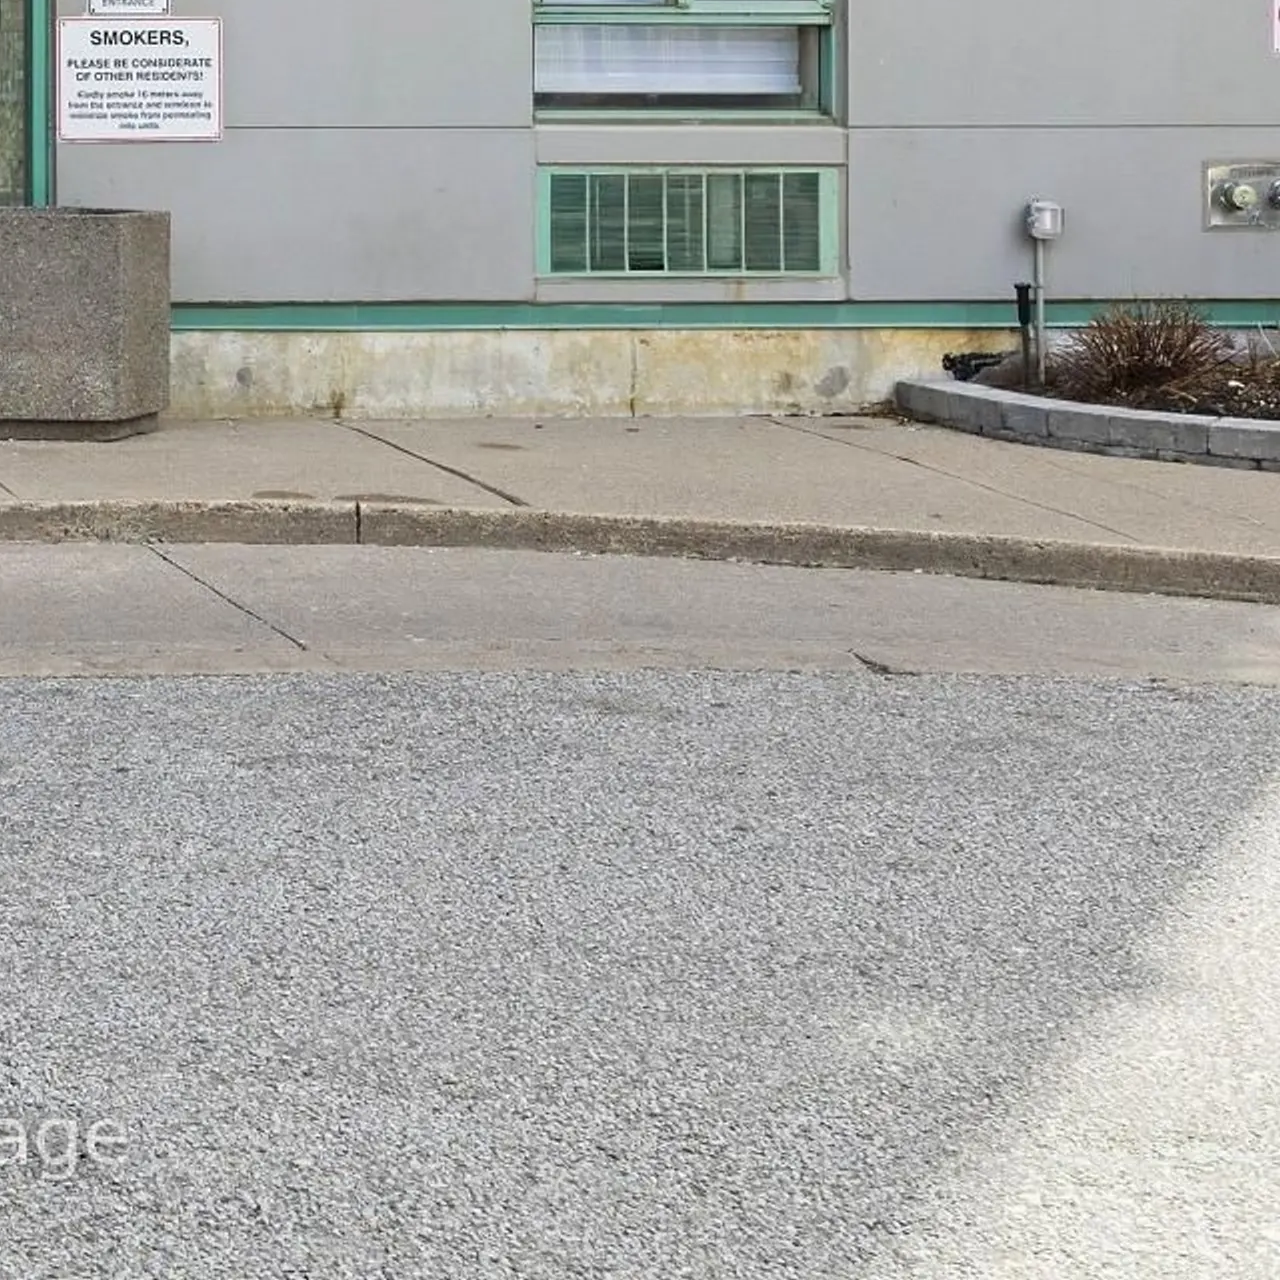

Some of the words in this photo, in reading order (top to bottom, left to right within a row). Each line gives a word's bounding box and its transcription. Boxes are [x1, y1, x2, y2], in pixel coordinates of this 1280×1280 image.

[90, 29, 190, 47] SMOKERS,
[66, 58, 111, 69] PLEASE
[114, 58, 129, 68] BE
[132, 58, 213, 68] CONSIDERATE
[76, 72, 91, 81] OF
[94, 72, 133, 81] OTHER
[136, 71, 204, 81] RESIDENTS!
